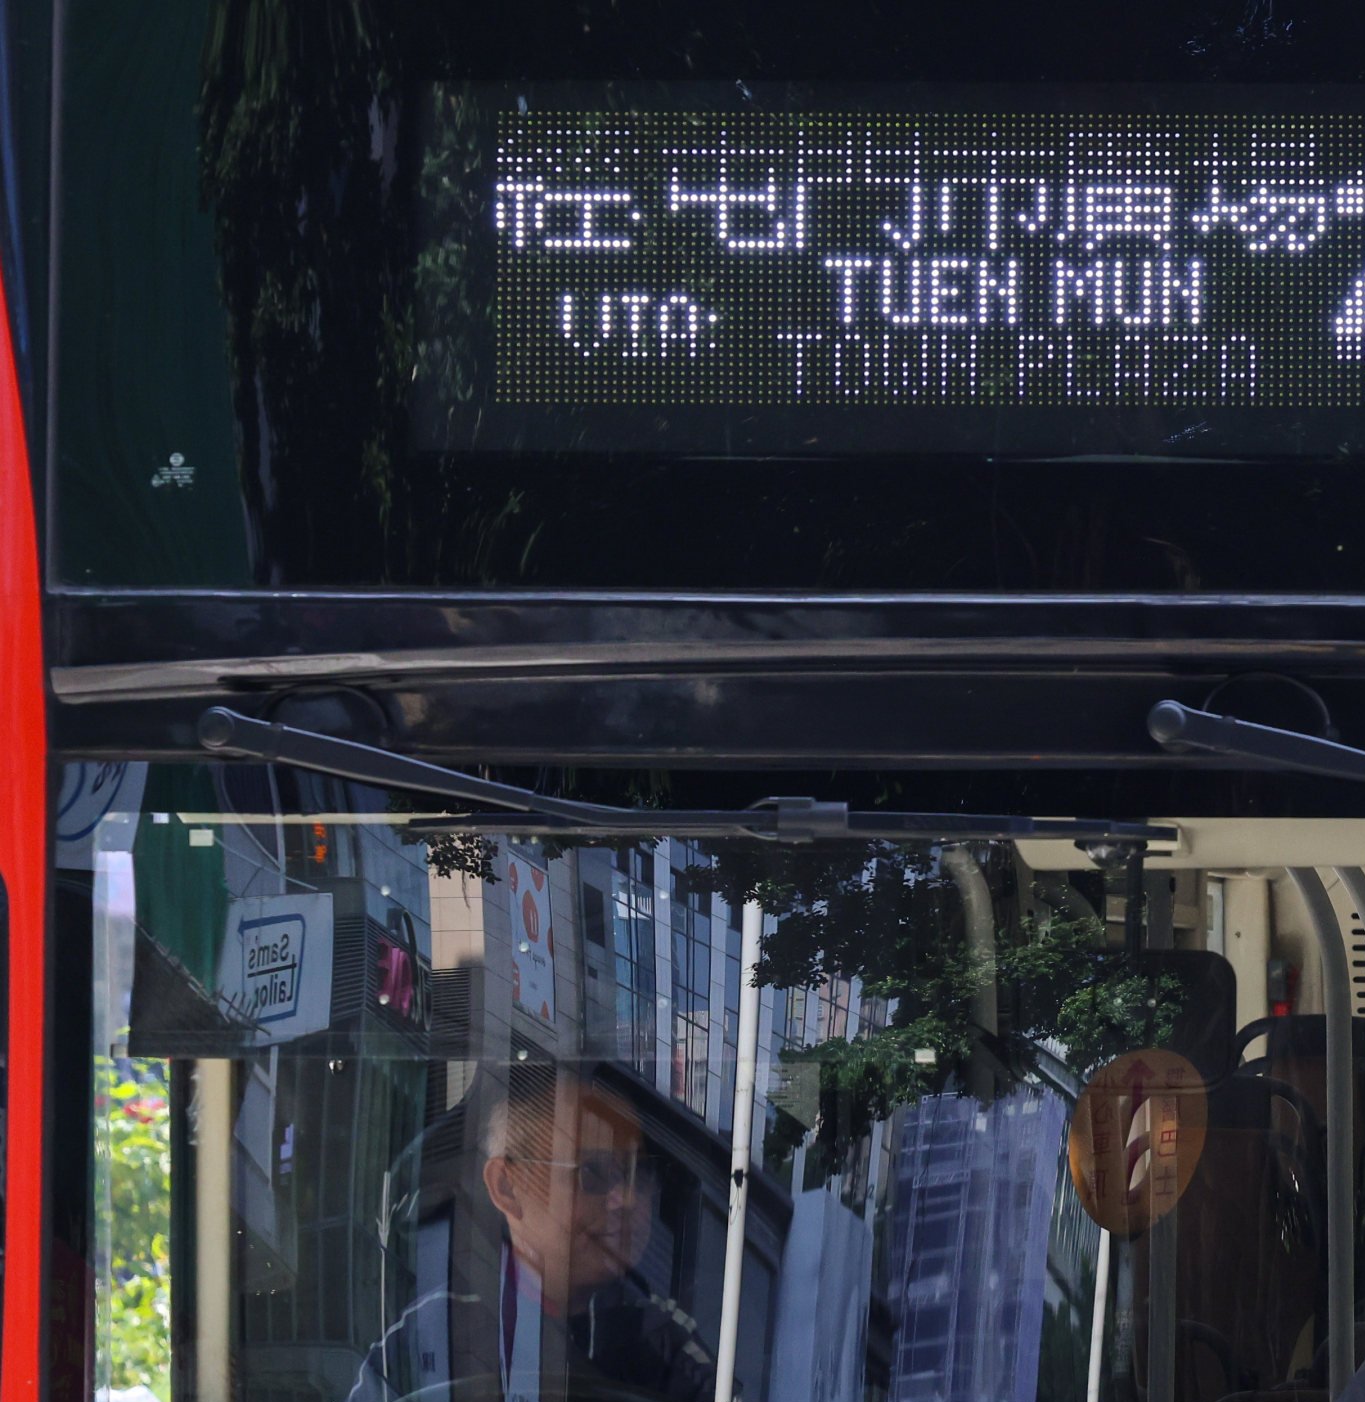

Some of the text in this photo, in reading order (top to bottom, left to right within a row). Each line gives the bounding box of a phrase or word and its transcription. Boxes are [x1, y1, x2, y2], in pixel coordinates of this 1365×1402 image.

[825, 259, 1199, 324] TUEN MUN
[777, 334, 1256, 397] TOWN PLAZA
